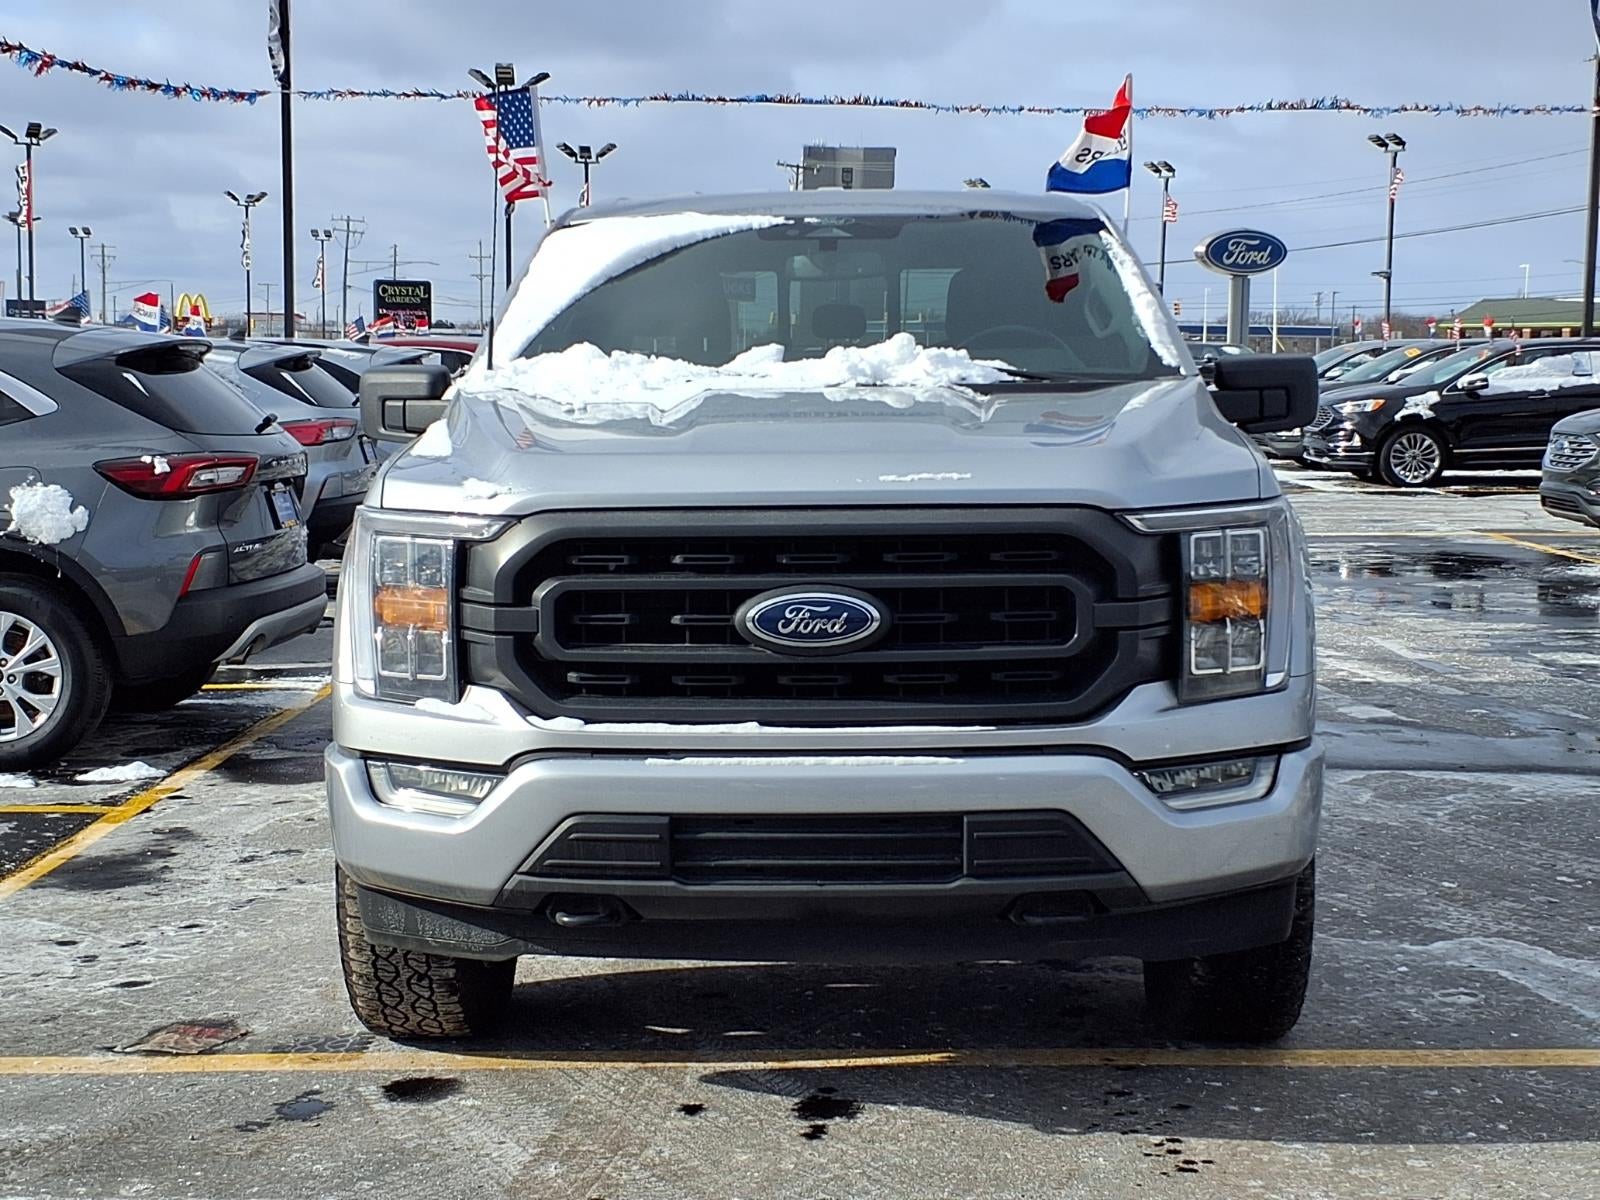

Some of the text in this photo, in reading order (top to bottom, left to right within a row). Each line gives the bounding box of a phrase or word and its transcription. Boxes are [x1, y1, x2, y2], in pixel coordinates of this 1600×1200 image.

[1222, 238, 1272, 265] Ford
[378, 284, 429, 298] CRYSTAL
[777, 604, 849, 634] Ford
